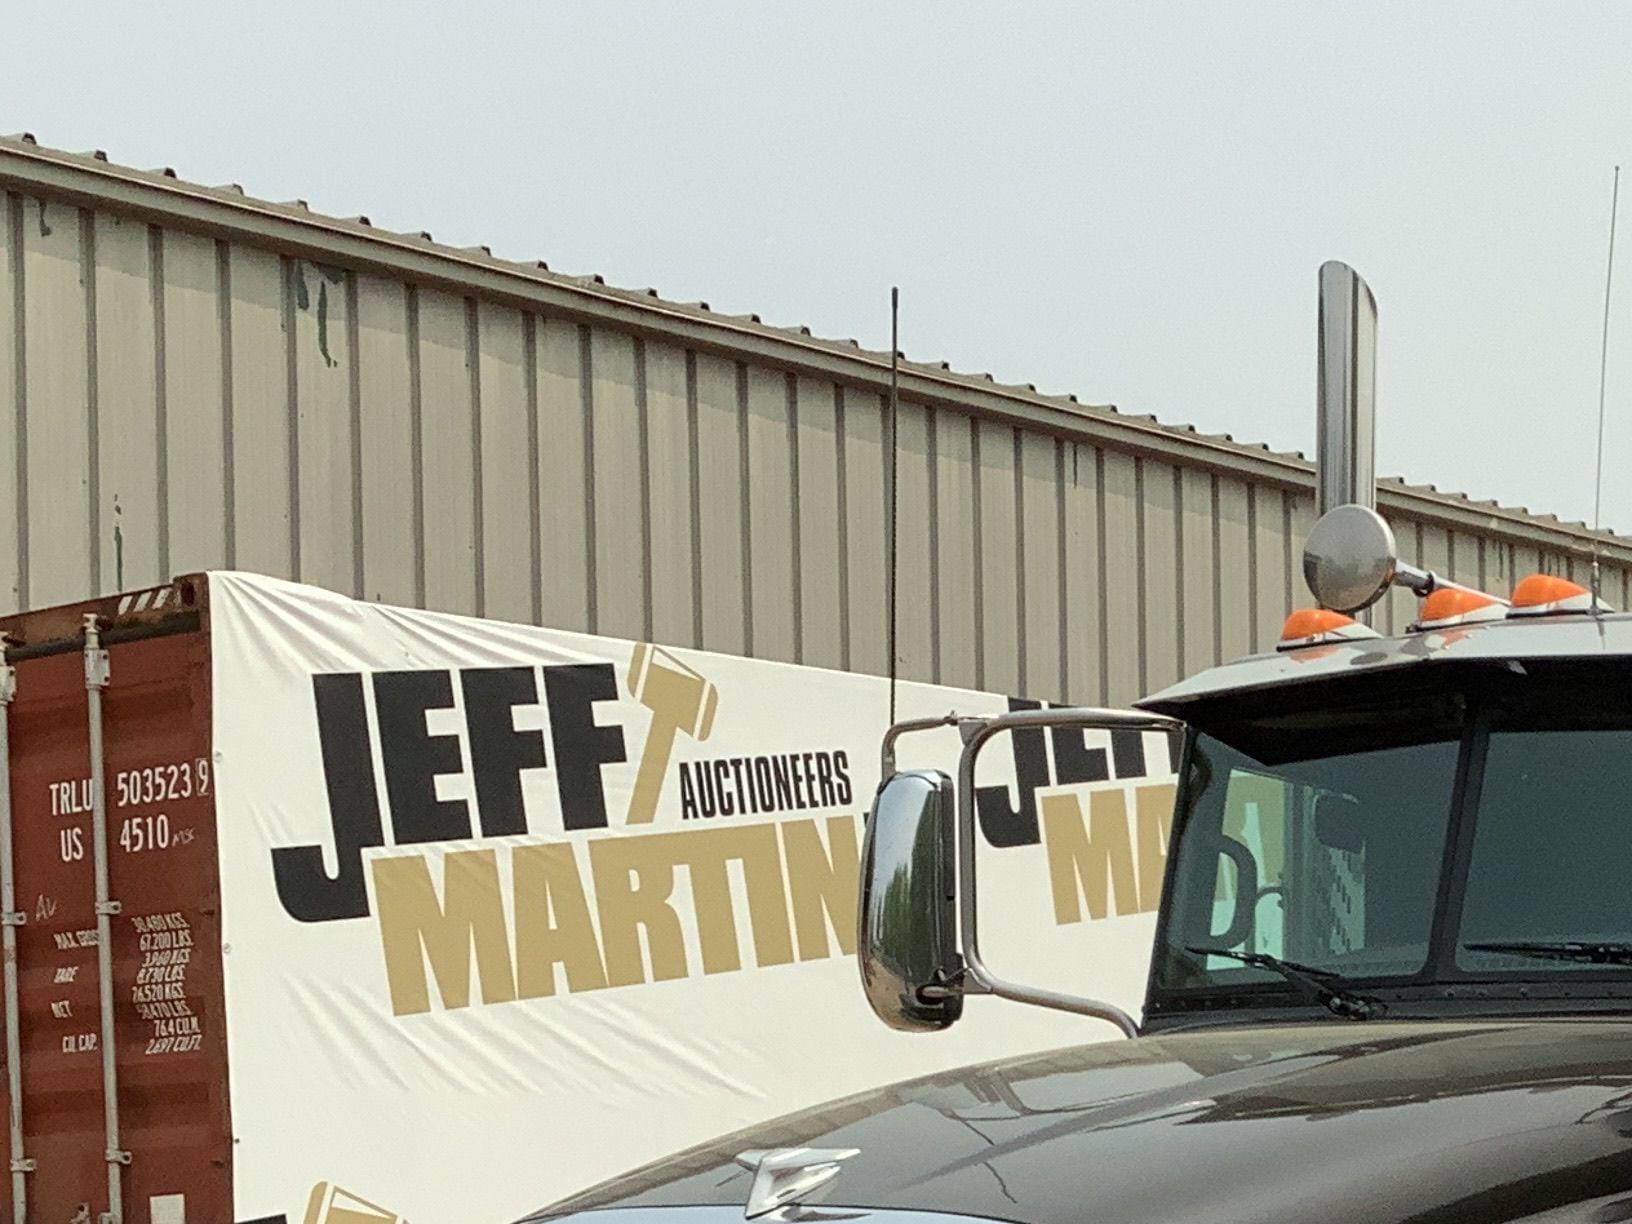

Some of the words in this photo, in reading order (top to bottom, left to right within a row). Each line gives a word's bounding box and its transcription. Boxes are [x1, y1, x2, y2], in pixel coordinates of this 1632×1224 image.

[49, 778, 93, 816] TRLU
[117, 762, 192, 807] 503523
[270, 662, 627, 924] JEFF
[678, 750, 853, 820] AUCTIONEERS
[60, 827, 84, 862] US
[119, 814, 169, 853] 4510
[370, 814, 862, 1018] MARTIN
